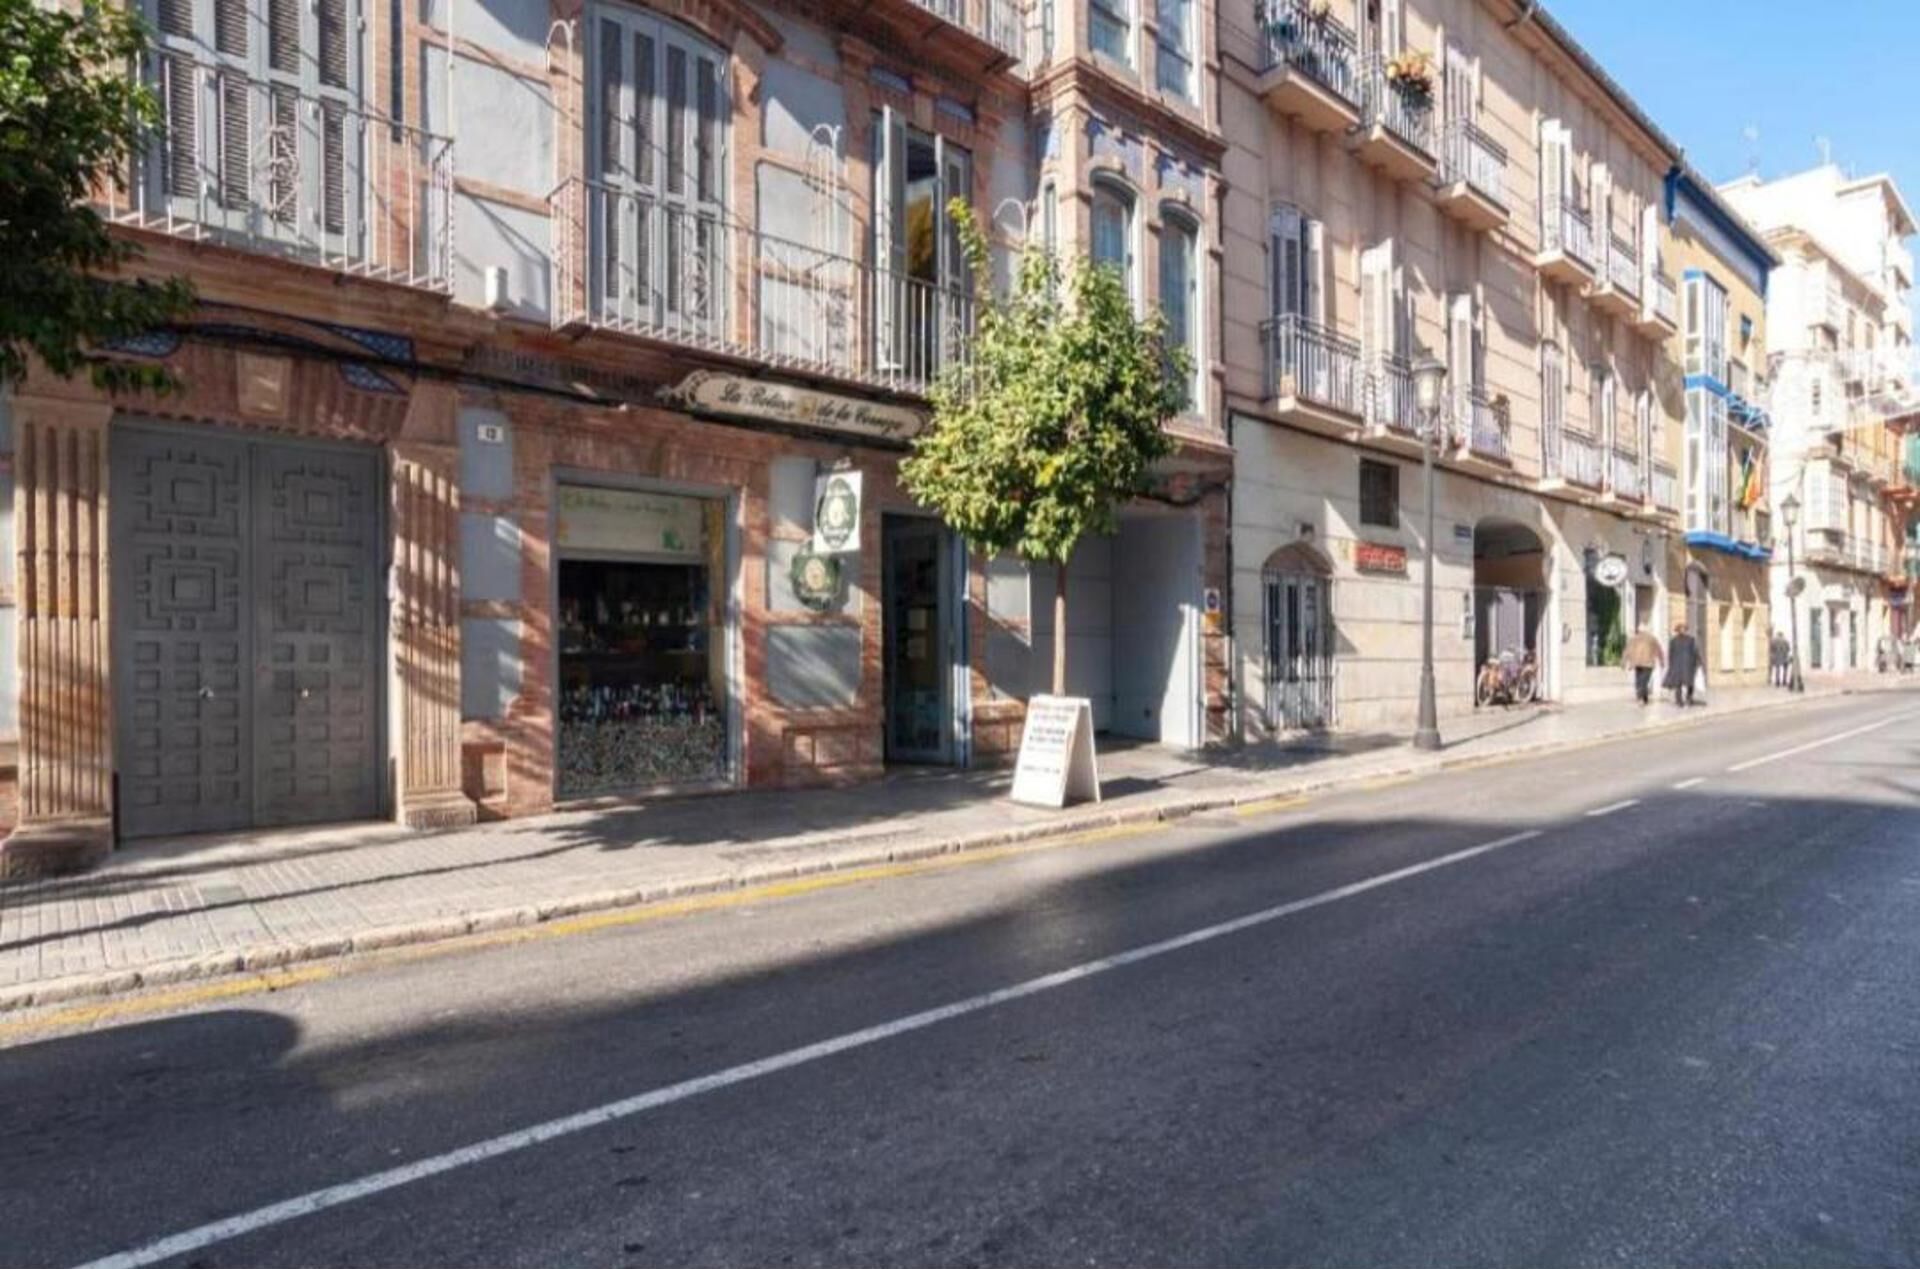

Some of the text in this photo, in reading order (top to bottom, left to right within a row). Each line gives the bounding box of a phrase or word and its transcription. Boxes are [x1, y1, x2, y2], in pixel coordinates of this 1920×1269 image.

[719, 382, 741, 401] La
[817, 400, 837, 418] de
[837, 402, 850, 420] la
